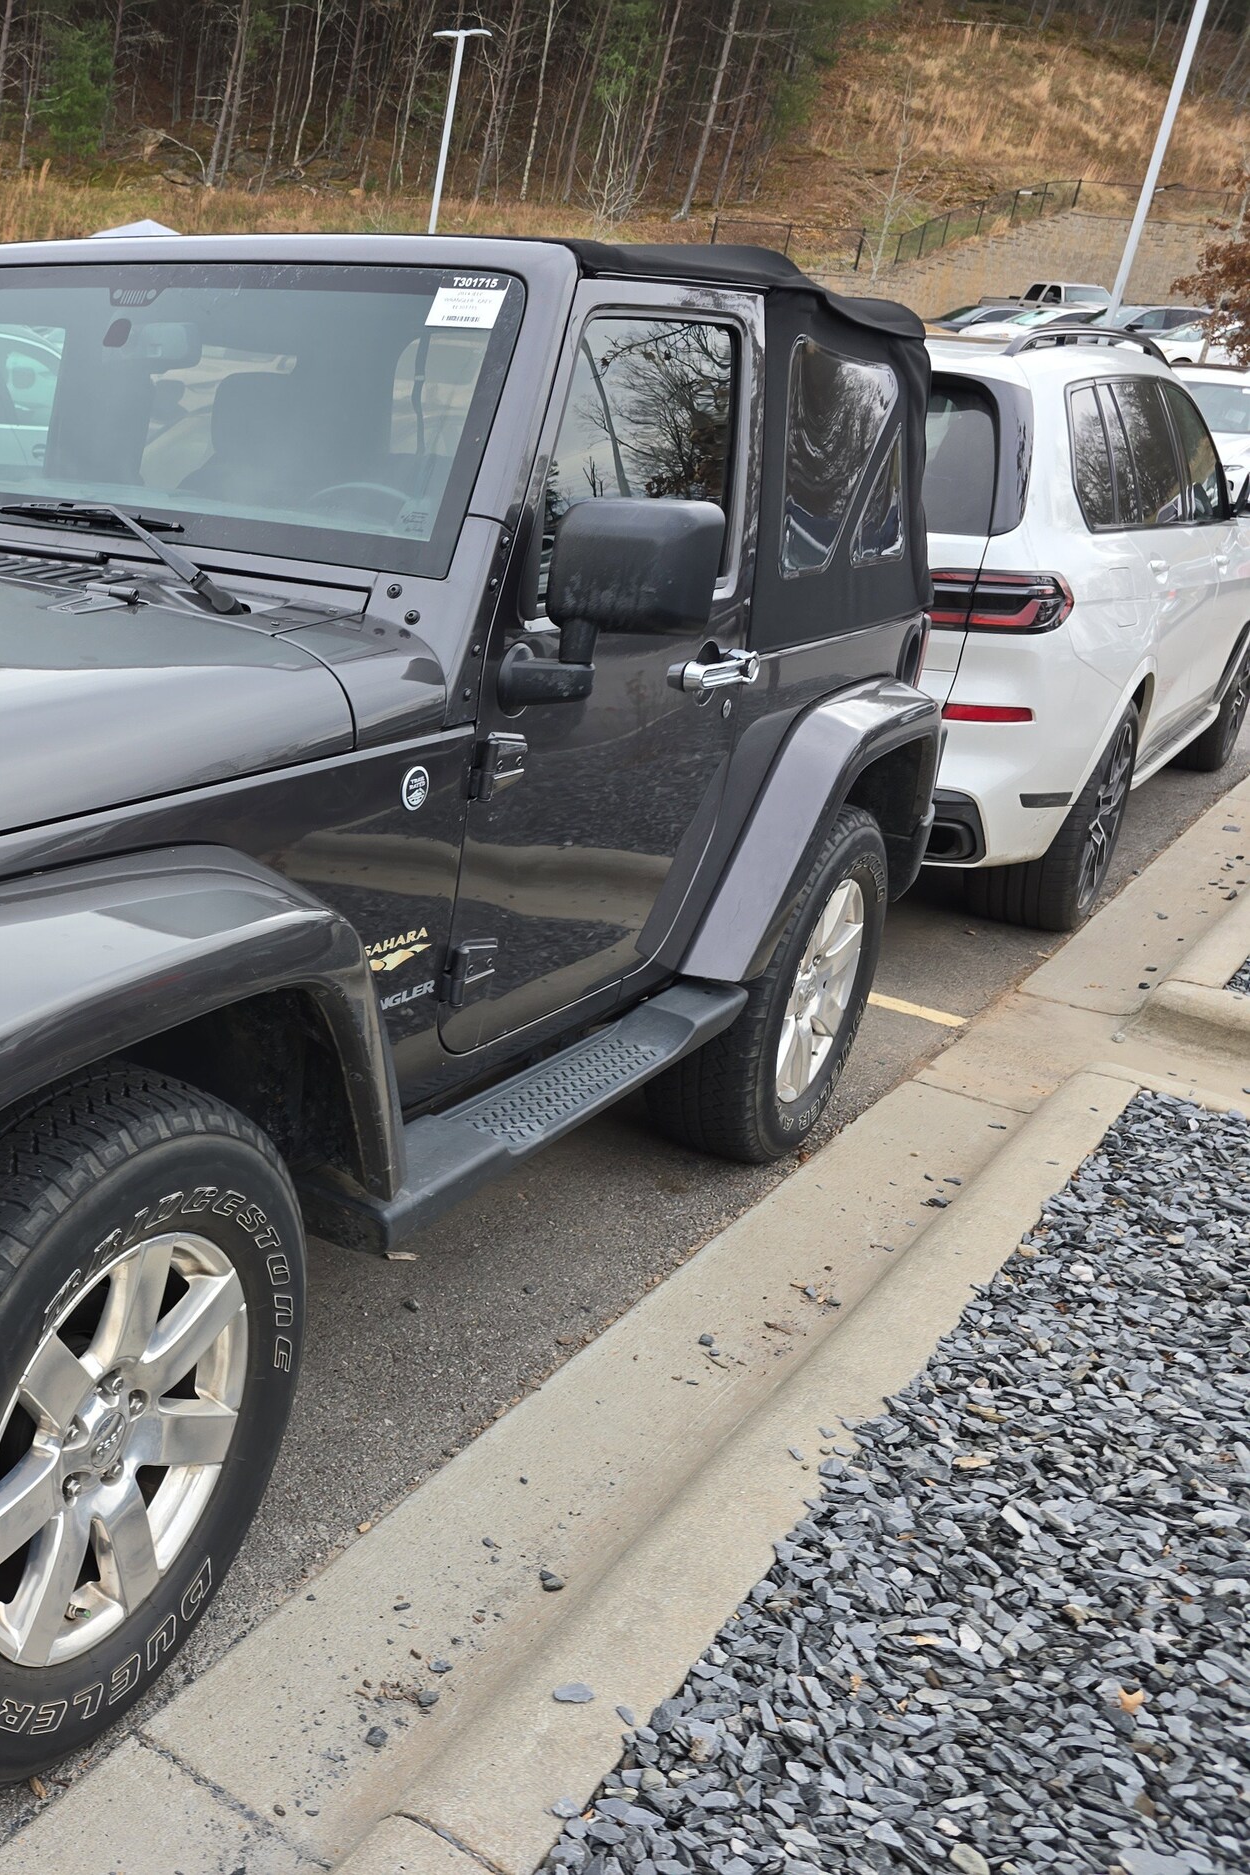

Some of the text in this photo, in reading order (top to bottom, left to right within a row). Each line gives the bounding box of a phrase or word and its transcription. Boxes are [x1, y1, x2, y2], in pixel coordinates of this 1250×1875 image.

[453, 277, 499, 288] T301715
[364, 927, 428, 956] SAHARA
[380, 979, 436, 1011] NGLER
